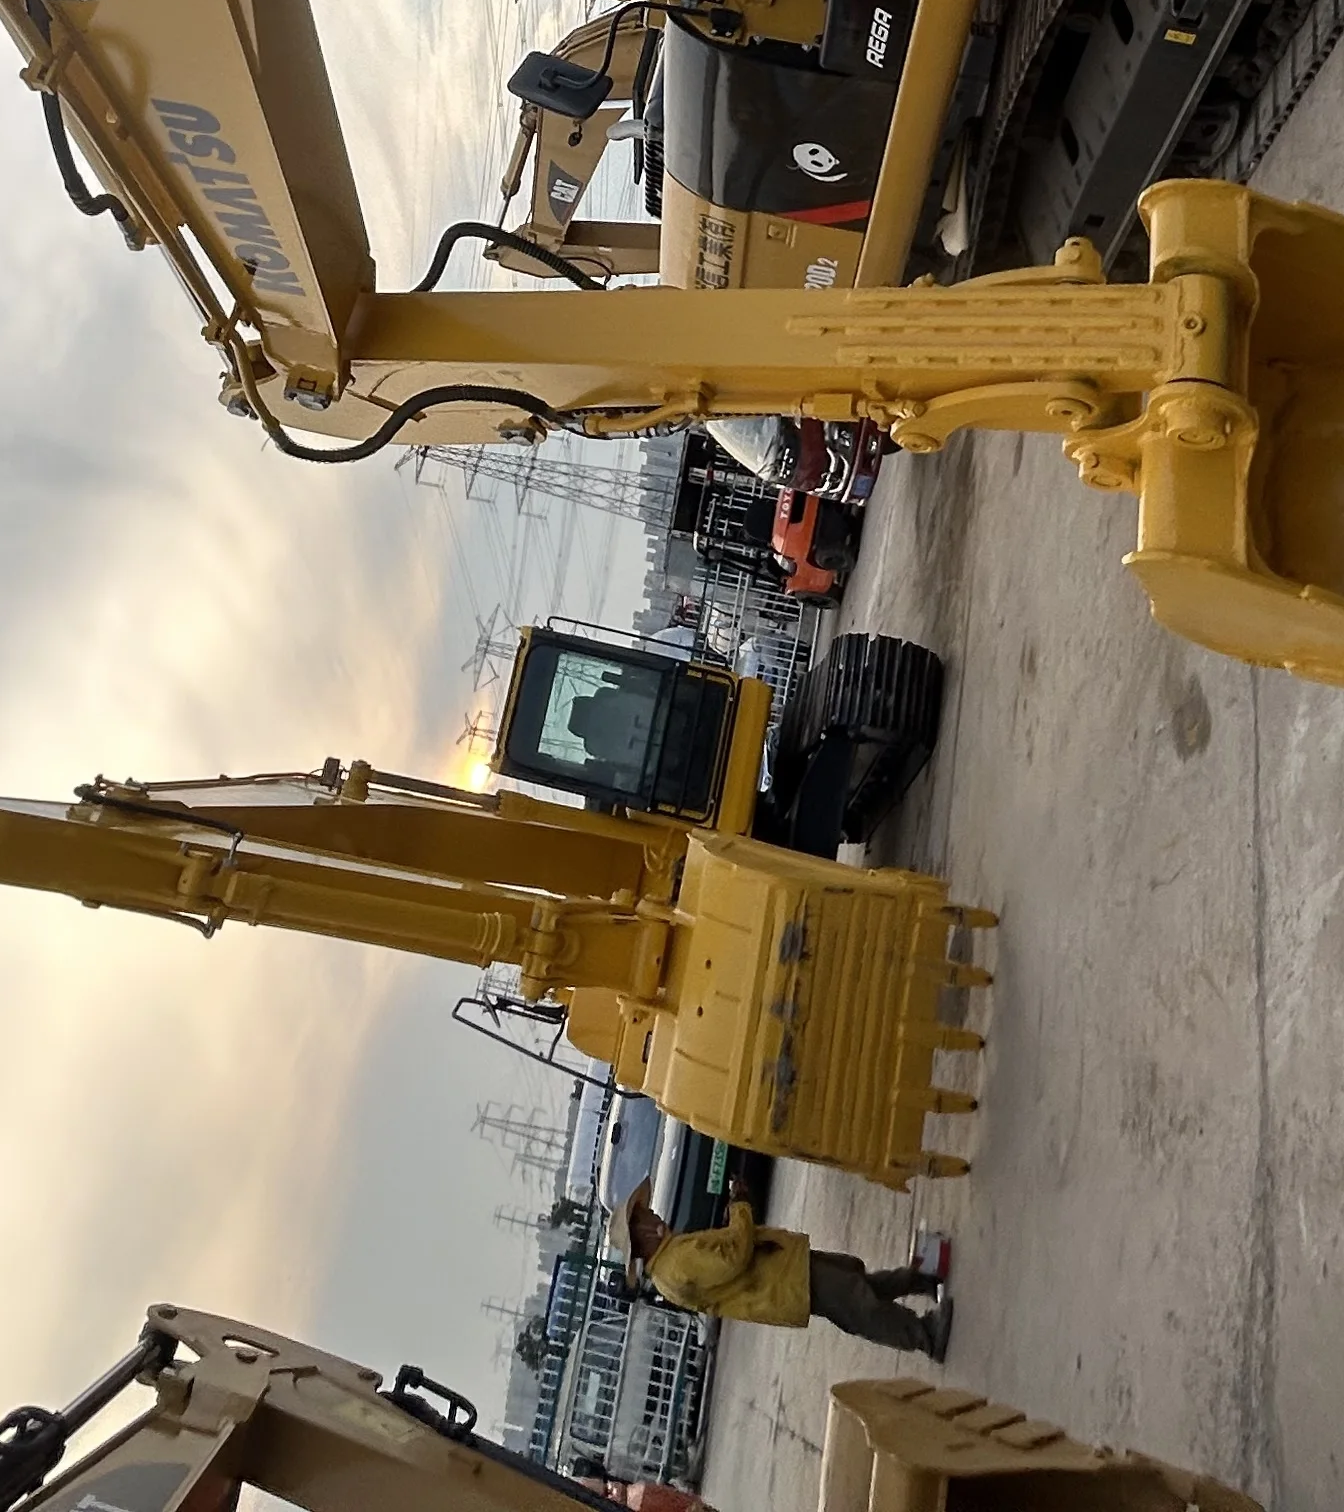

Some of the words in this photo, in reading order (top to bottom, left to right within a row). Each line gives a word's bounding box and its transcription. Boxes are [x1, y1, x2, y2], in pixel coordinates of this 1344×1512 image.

[865, 7, 893, 69] REGA
[150, 98, 306, 296] KOMATSU
[550, 178, 579, 203] CAT
